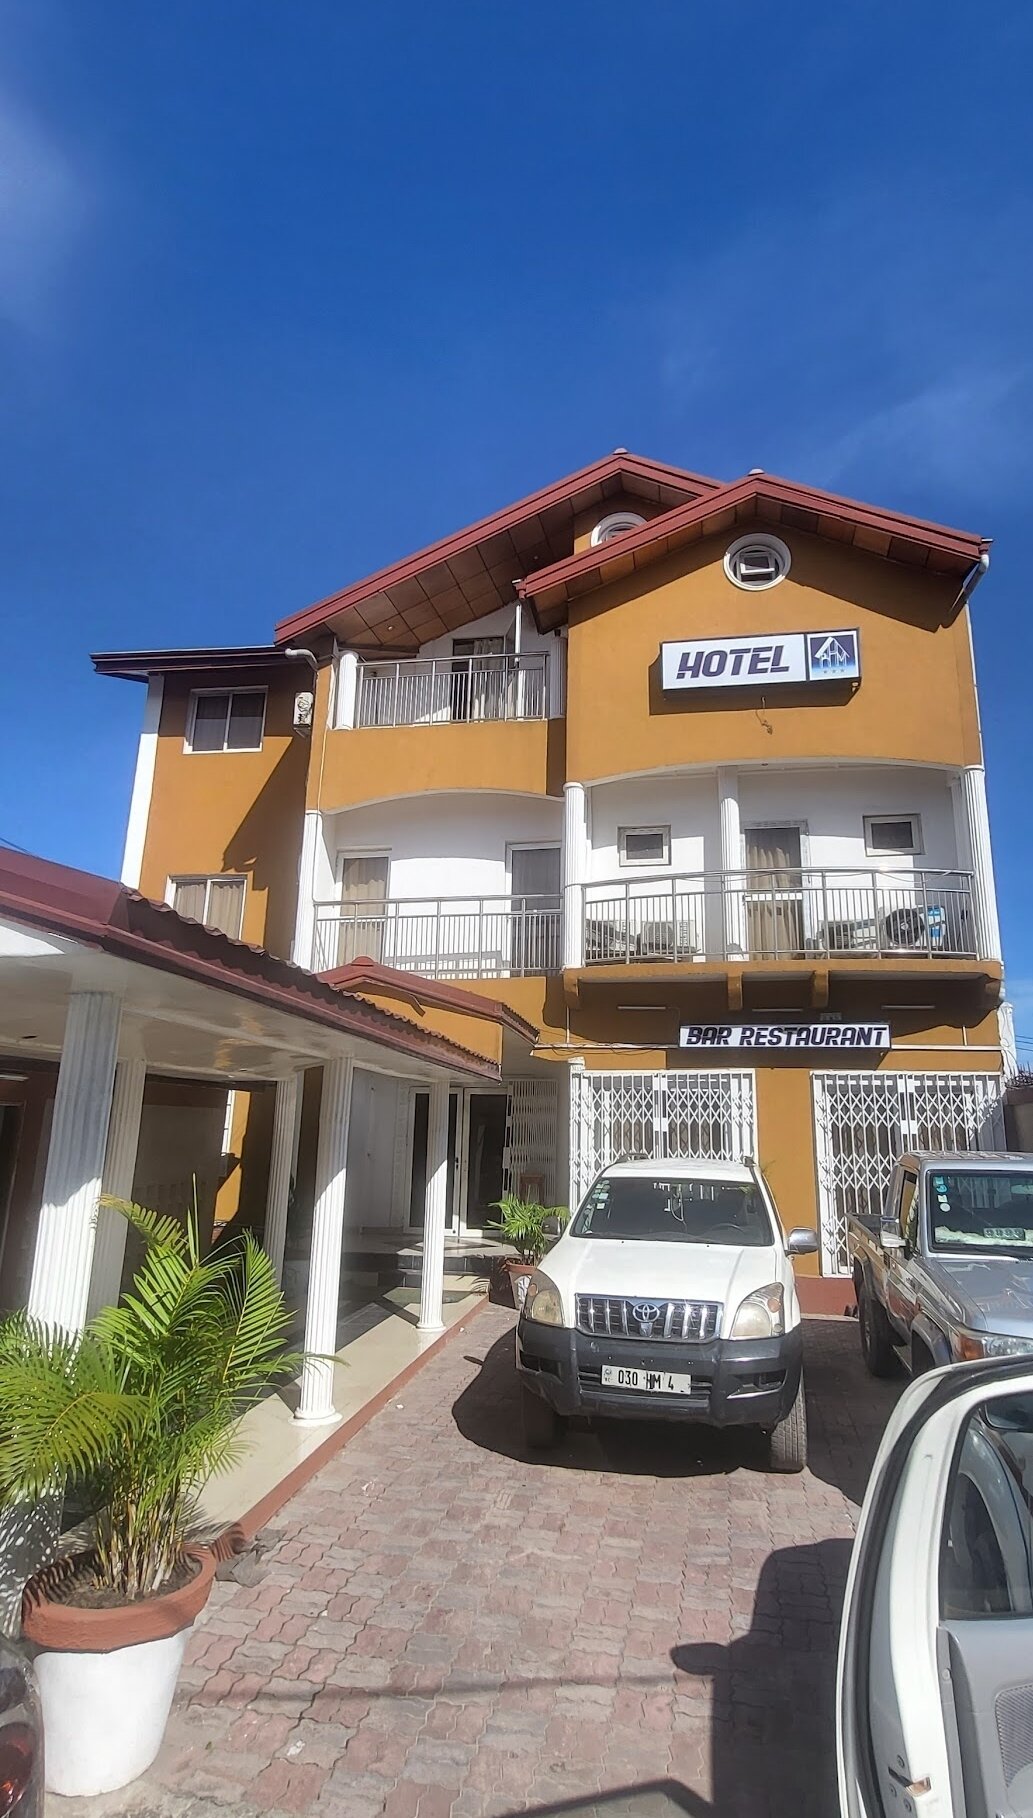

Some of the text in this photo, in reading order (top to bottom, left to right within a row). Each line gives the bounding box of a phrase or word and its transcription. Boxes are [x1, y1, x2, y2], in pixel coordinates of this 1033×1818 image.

[676, 645, 789, 679] HOTEL
[686, 1026, 887, 1046] BAR RESTAURANT
[618, 1370, 638, 1386] 030
[668, 1375, 674, 1391] 4
